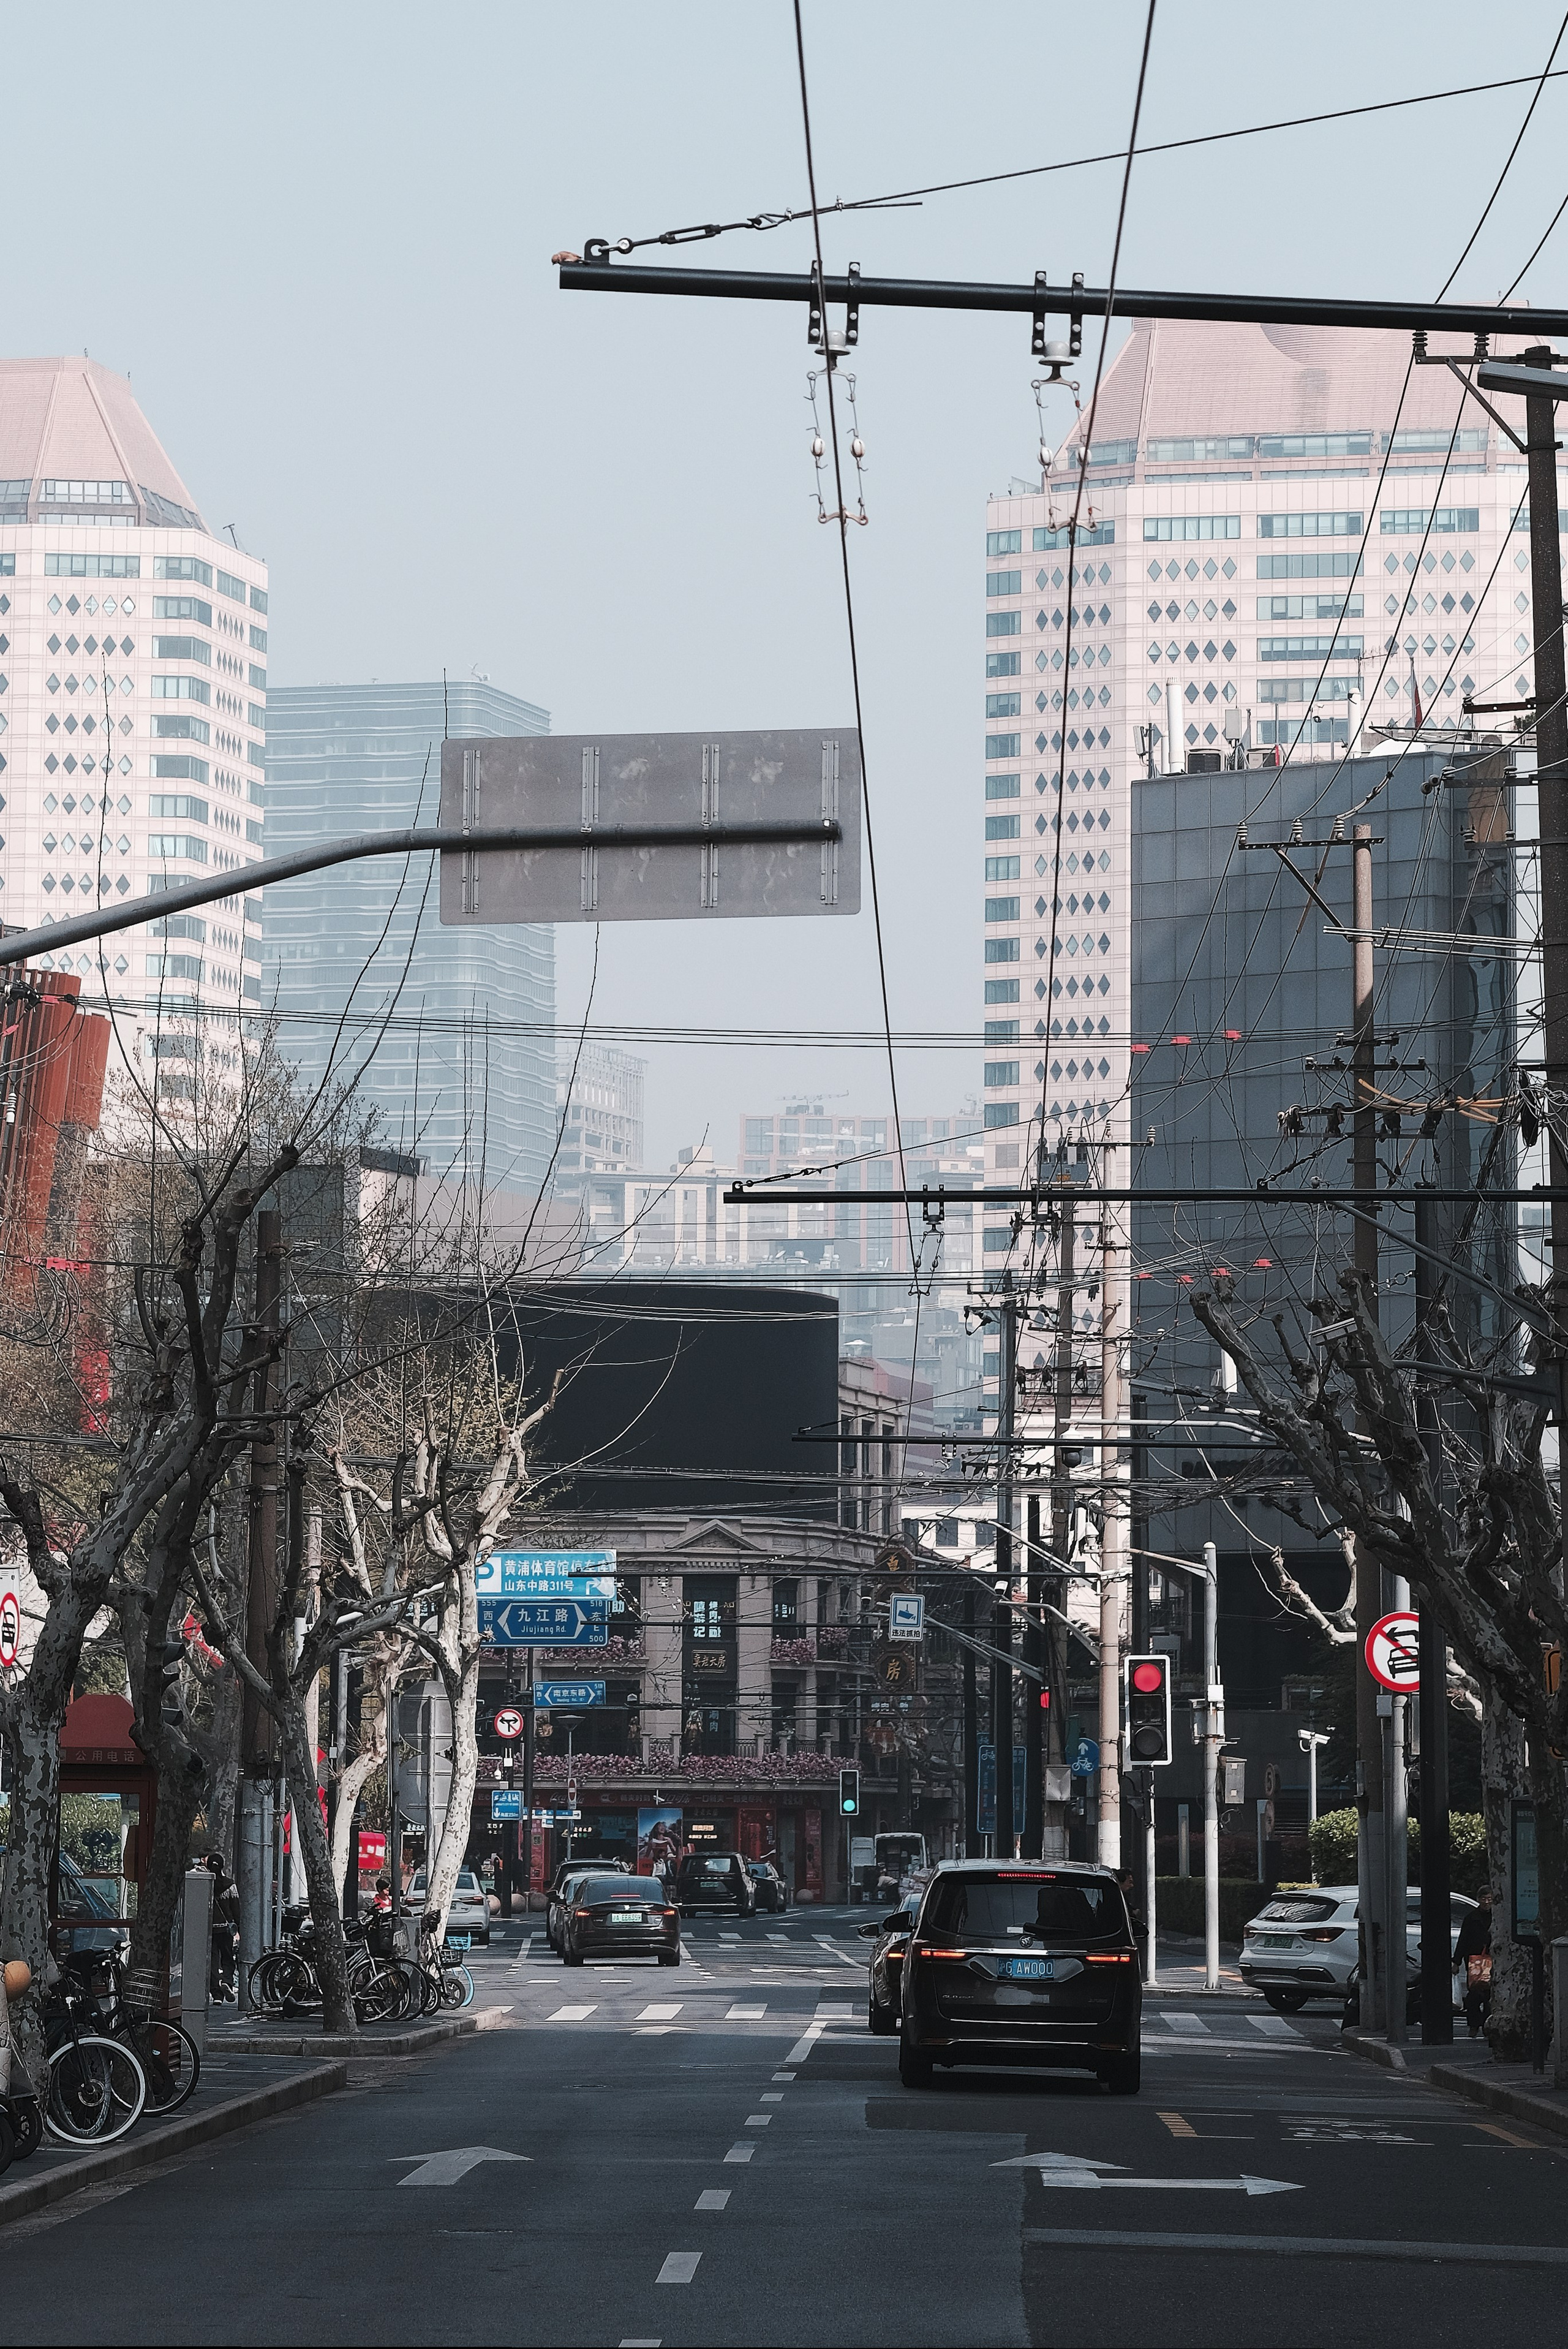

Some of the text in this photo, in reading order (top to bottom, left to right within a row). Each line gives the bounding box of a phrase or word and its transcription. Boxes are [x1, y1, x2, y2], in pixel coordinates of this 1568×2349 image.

[504, 1579, 575, 1592] 山东中路311号
[483, 1611, 494, 1621] 西
[517, 1608, 569, 1622] 九江路
[591, 1611, 603, 1621] 东
[484, 1624, 492, 1632] W
[521, 1625, 554, 1635] Jiujiang
[892, 1629, 920, 1638] 违法抓拍
[553, 1689, 586, 1697] 南京东路
[75, 1750, 135, 1763] 公用电话
